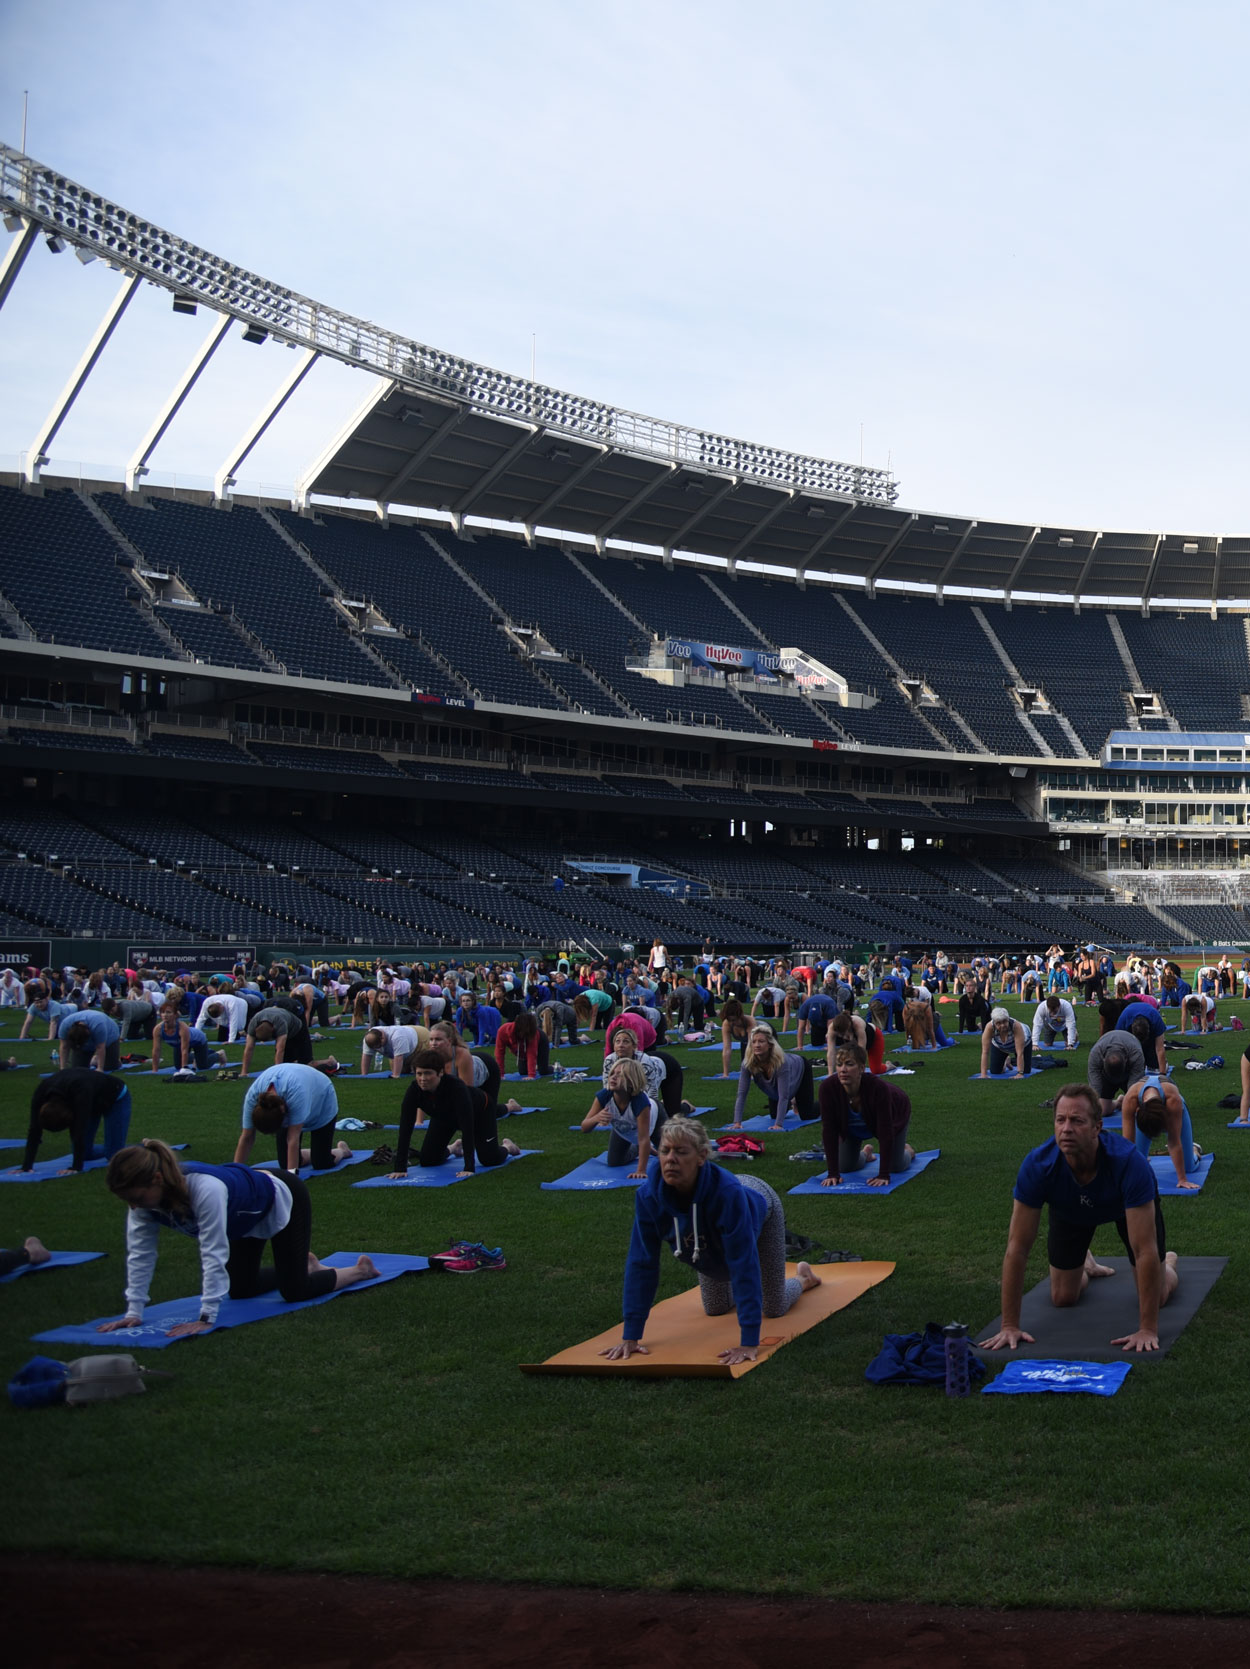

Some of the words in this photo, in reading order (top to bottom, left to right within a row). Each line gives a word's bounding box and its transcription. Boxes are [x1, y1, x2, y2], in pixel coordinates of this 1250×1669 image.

[705, 645, 743, 662] HyVee
[446, 698, 466, 707] LEVEL
[1080, 1194, 1094, 1208] KC
